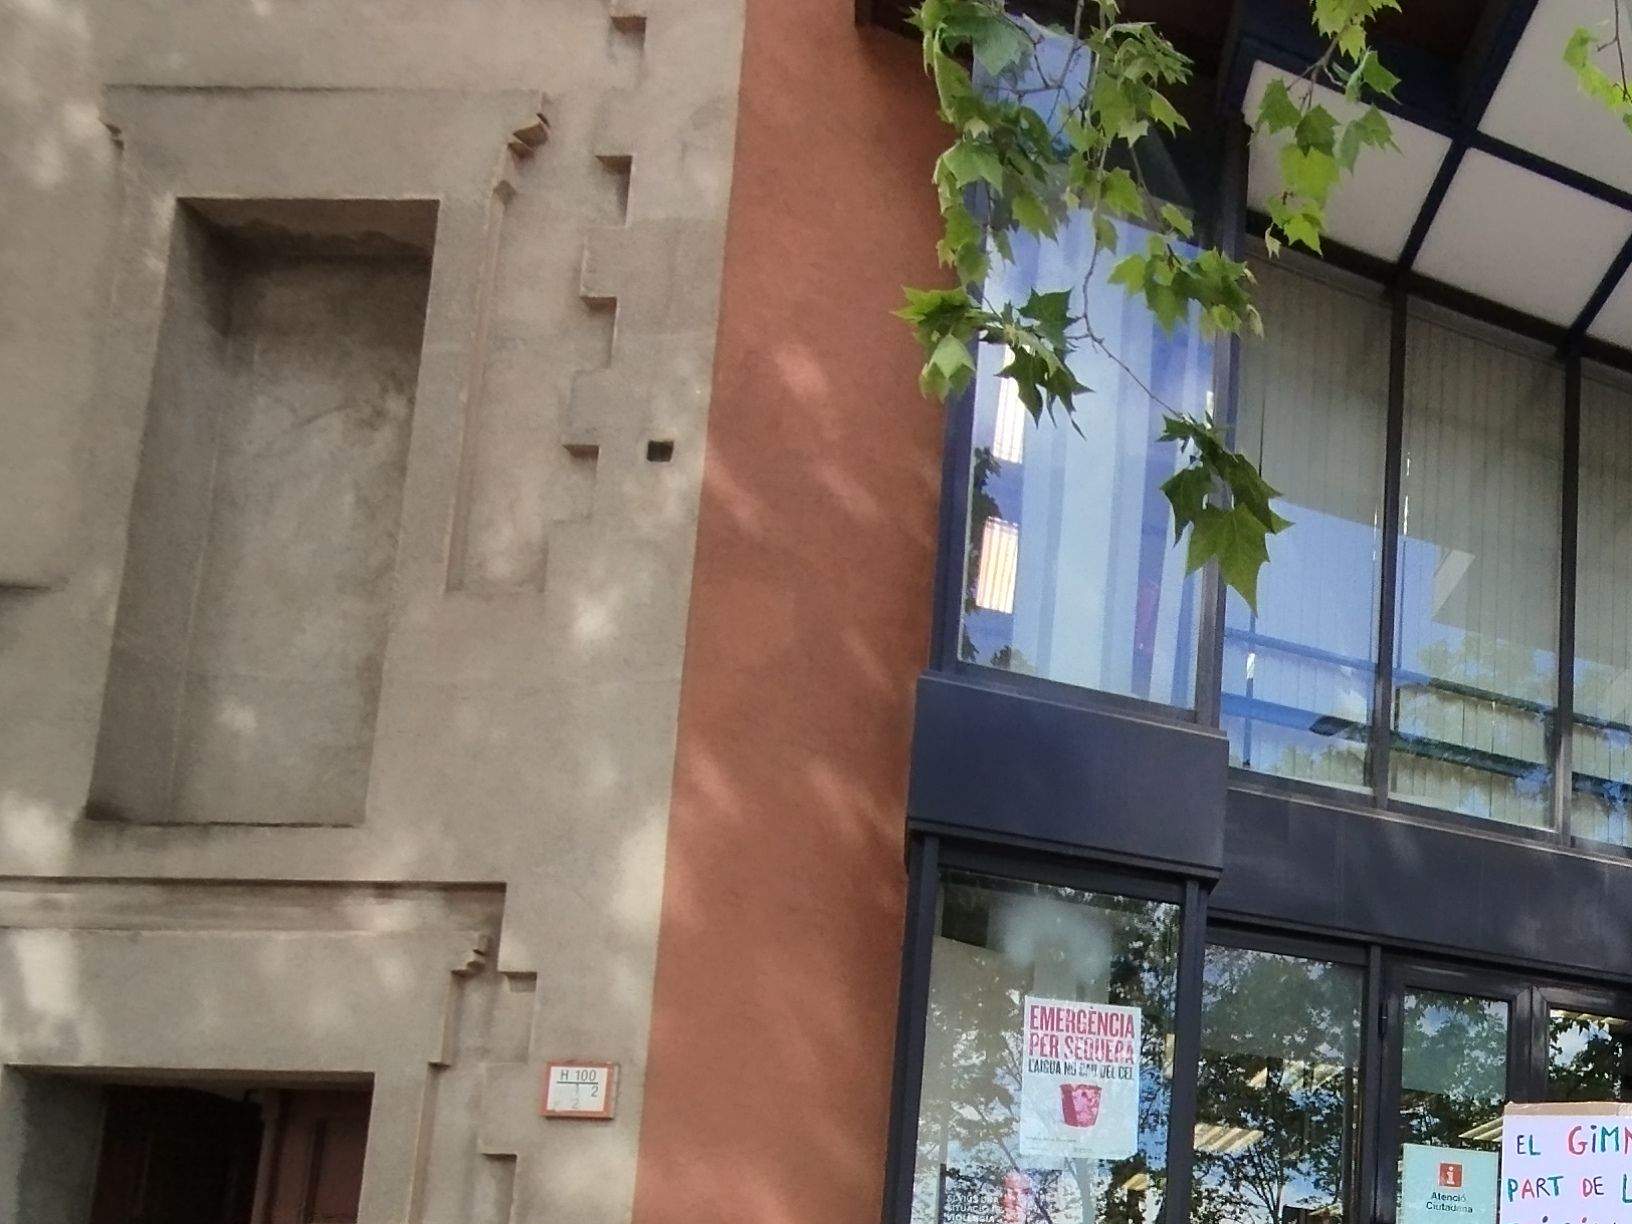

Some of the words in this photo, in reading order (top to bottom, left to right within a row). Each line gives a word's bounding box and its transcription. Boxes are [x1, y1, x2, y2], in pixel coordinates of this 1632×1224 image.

[1029, 1032, 1059, 1059] PER
[561, 1070, 569, 1081] H
[576, 1070, 597, 1082] 100
[1516, 1134, 1542, 1156] EL
[1506, 1175, 1565, 1202] PART
[1581, 1176, 1605, 1197] DE
